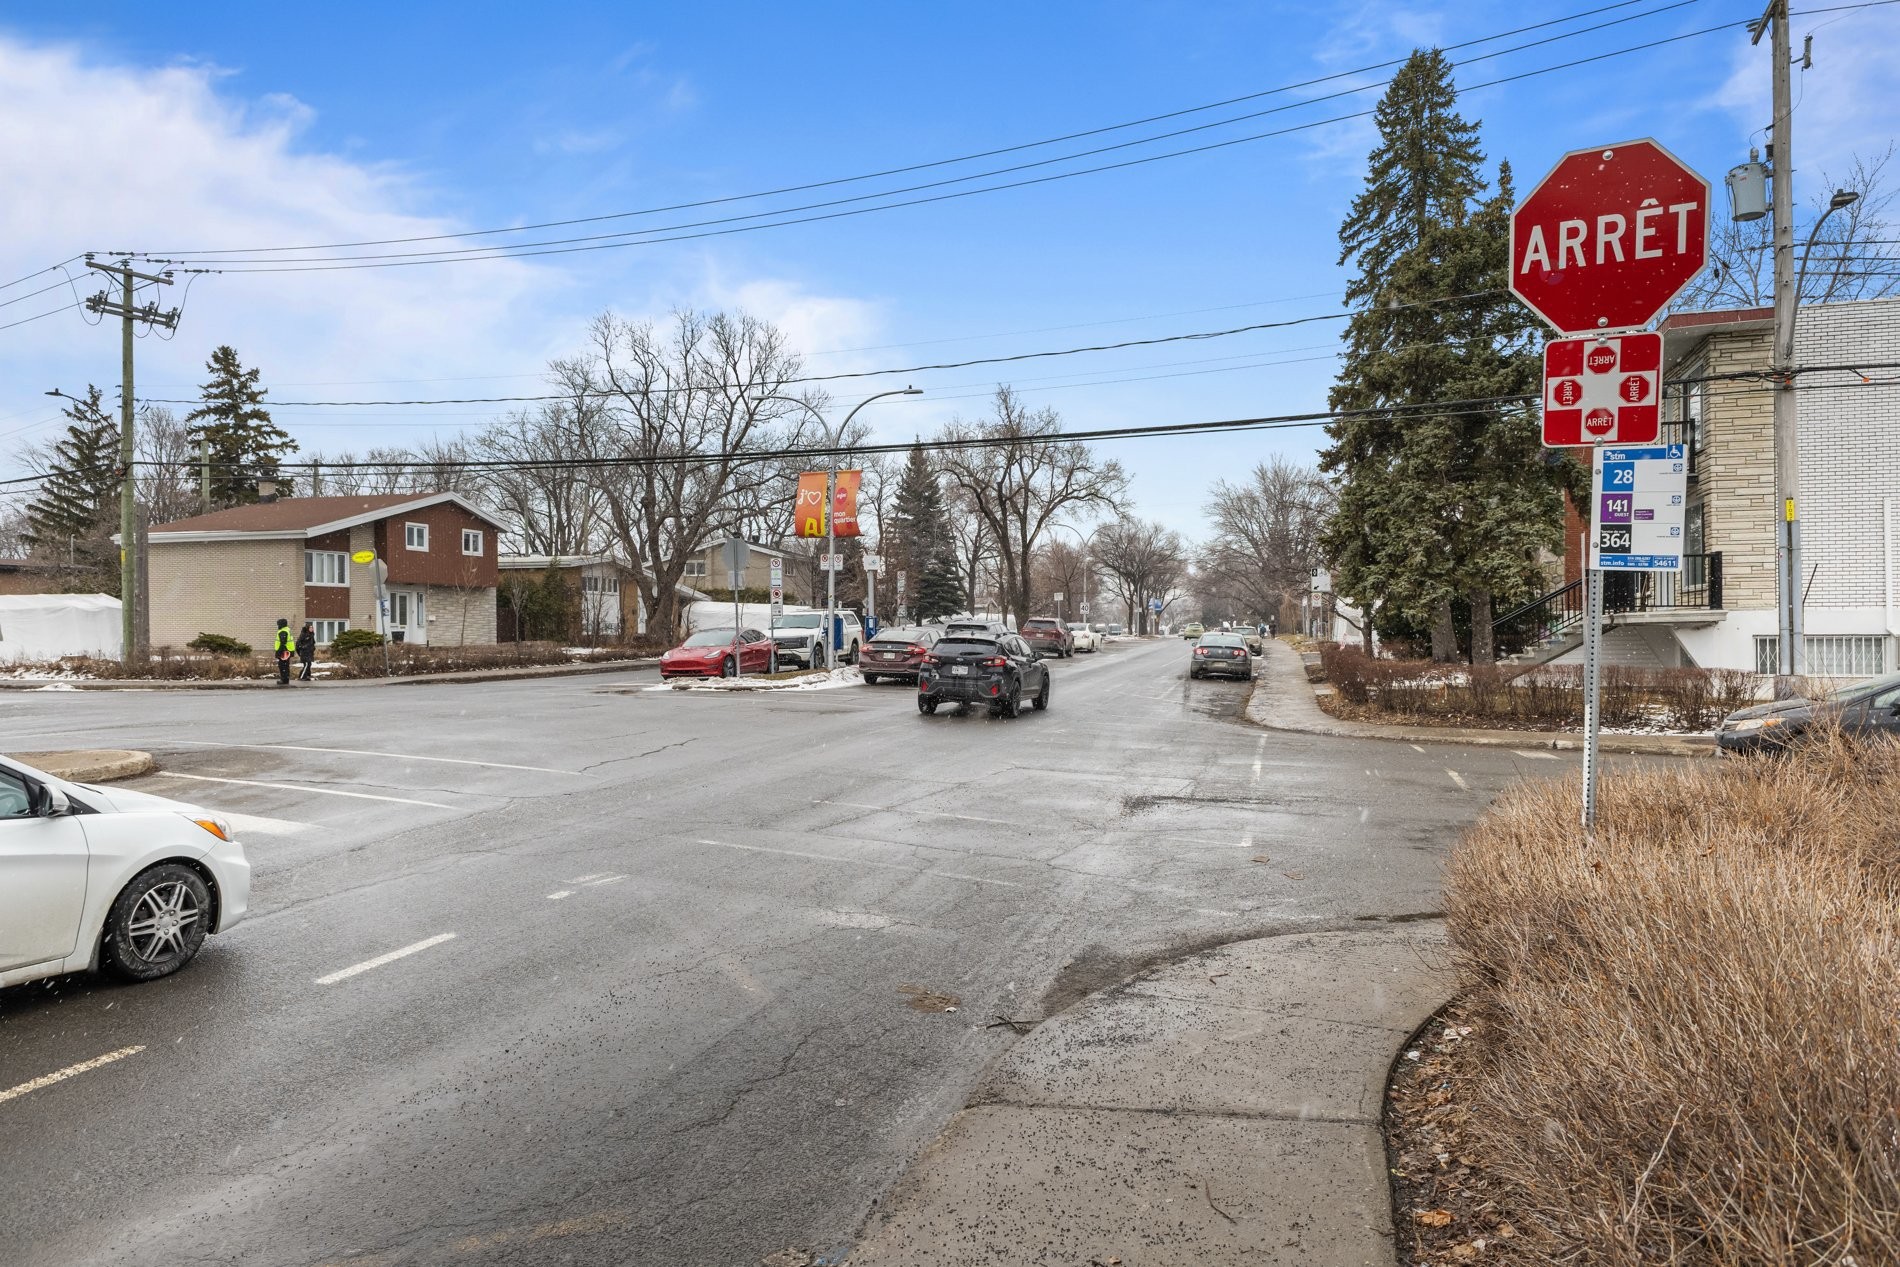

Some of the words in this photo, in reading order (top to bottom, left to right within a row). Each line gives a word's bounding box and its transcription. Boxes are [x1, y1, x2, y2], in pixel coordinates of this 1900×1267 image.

[1520, 197, 1698, 275] ARRÊT
[1588, 355, 1616, 367] ARRÊT
[1562, 380, 1573, 405] ARRÊT
[1626, 376, 1640, 402] ARRÊT
[1586, 415, 1613, 427] ARRÊT
[1610, 452, 1626, 461] stm
[1613, 469, 1633, 484] 28
[1606, 499, 1629, 512] 141
[1600, 533, 1631, 548] 364
